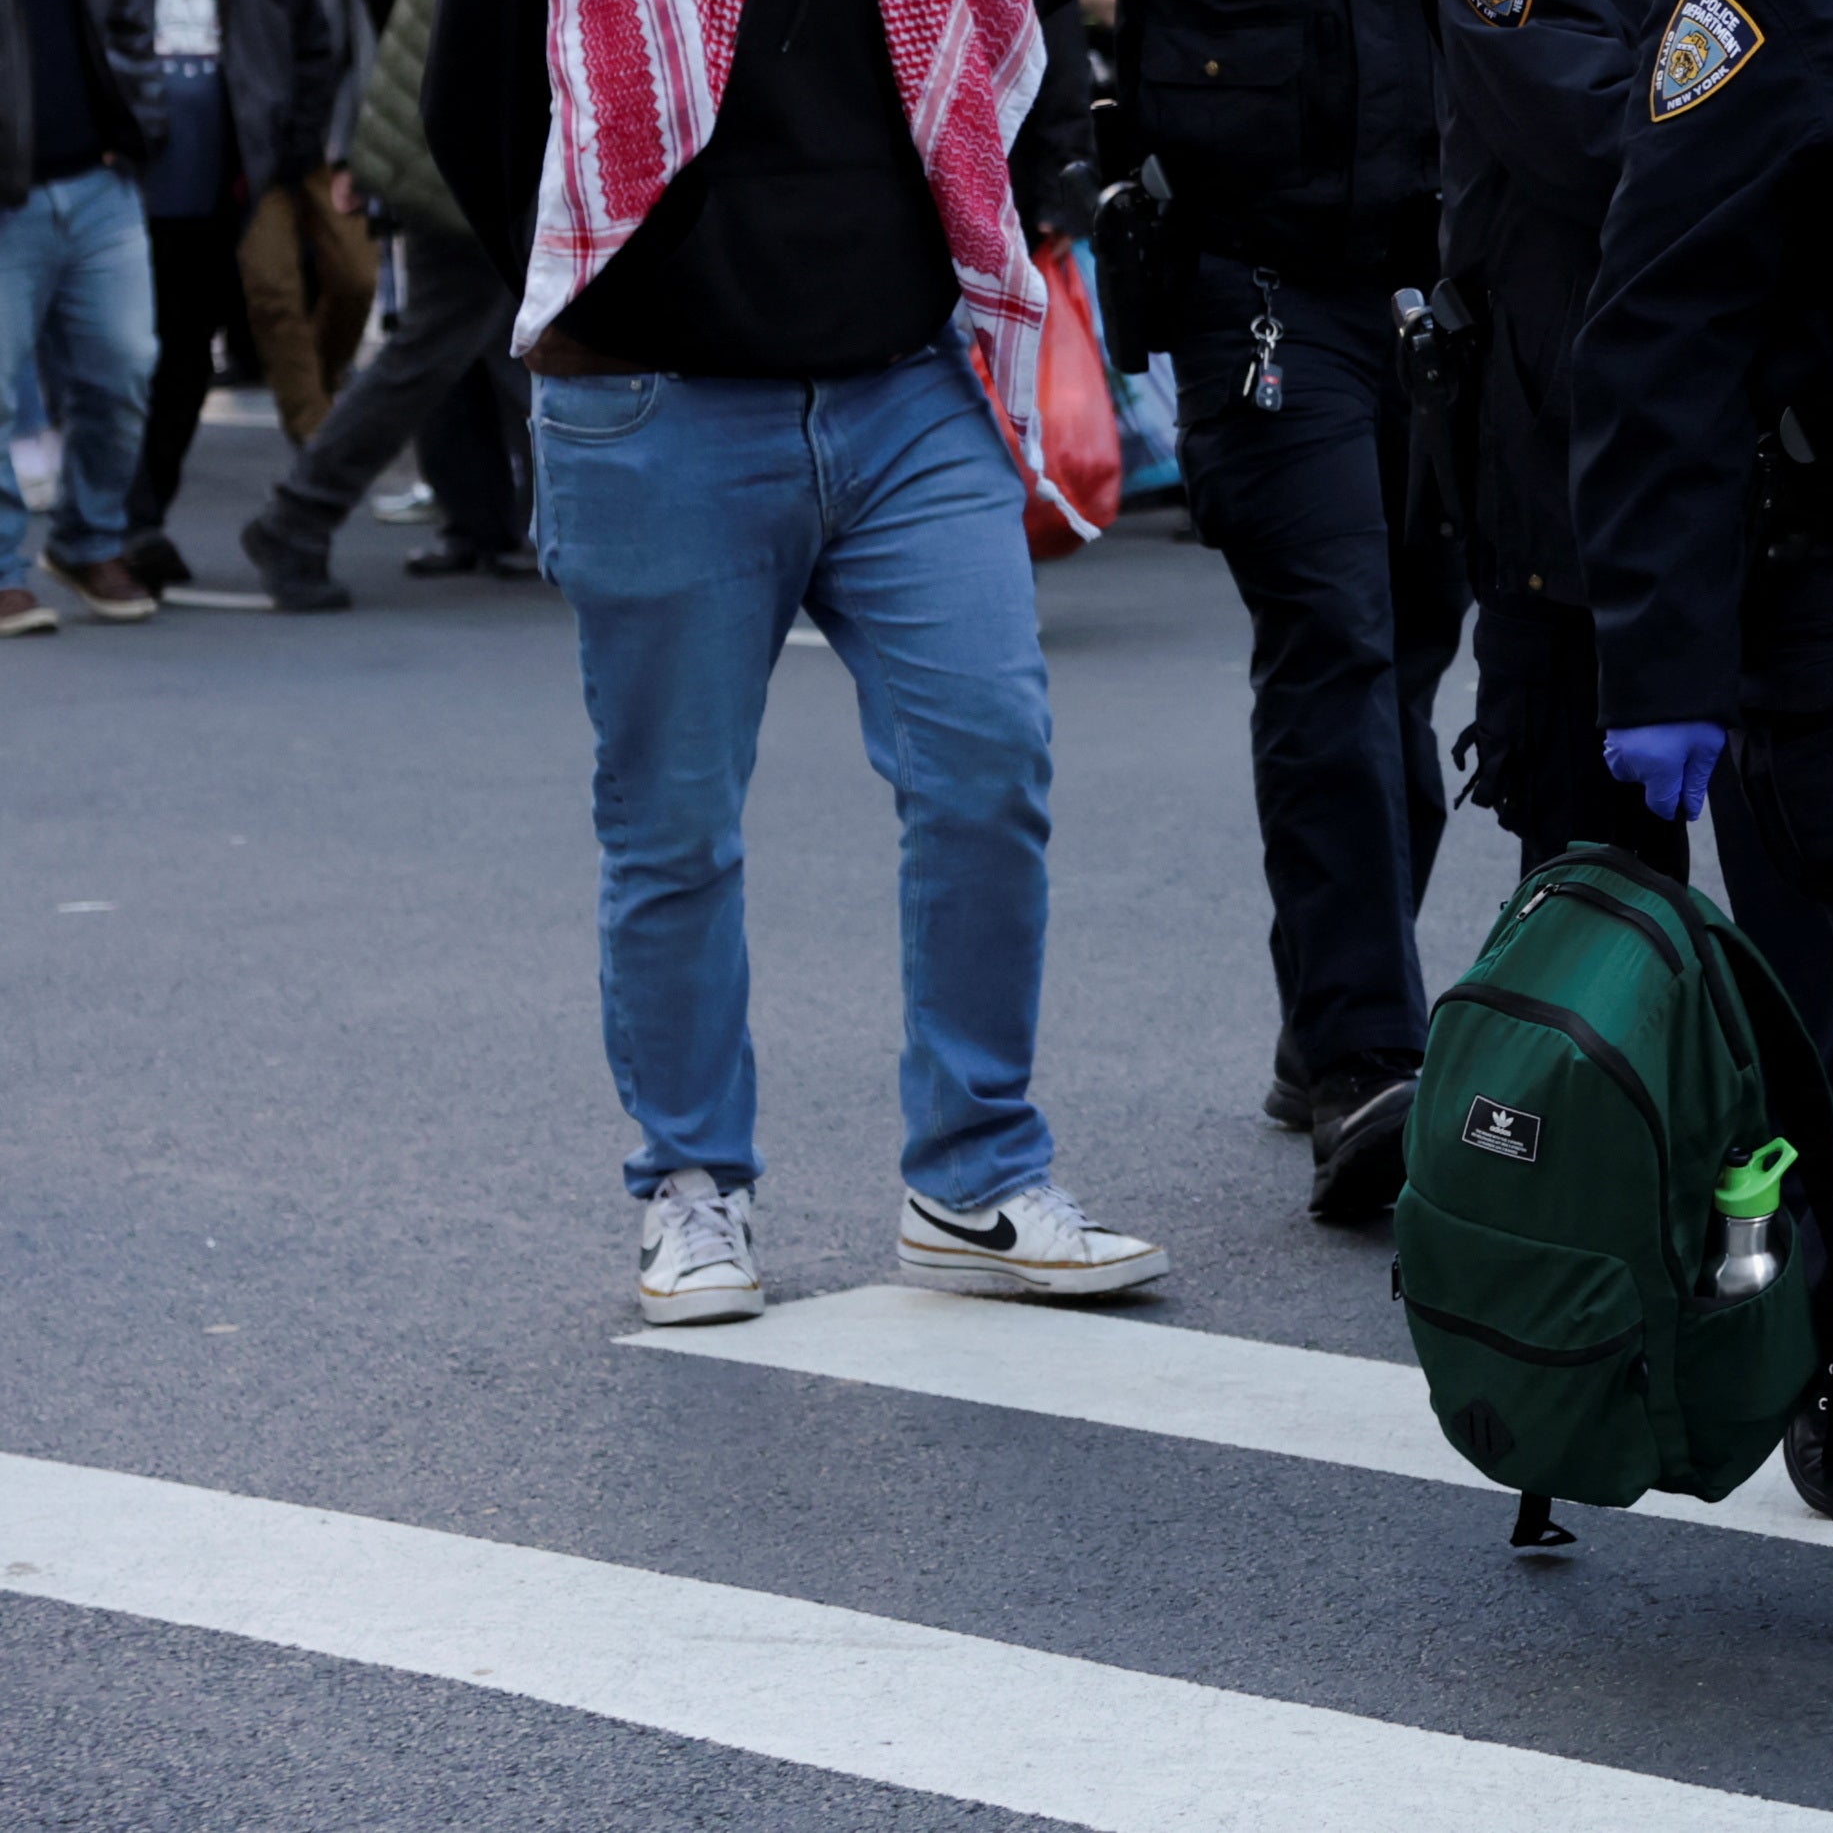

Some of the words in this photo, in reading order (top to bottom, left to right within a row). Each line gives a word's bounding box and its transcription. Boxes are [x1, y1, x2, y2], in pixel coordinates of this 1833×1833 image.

[1483, 7, 1498, 20] OF
[1681, 2, 1742, 59] DEPARTMENT
[1659, 30, 1675, 67] CITY
[1655, 70, 1664, 91] OF
[1666, 92, 1692, 111] NEW
[1694, 65, 1730, 95] YORK
